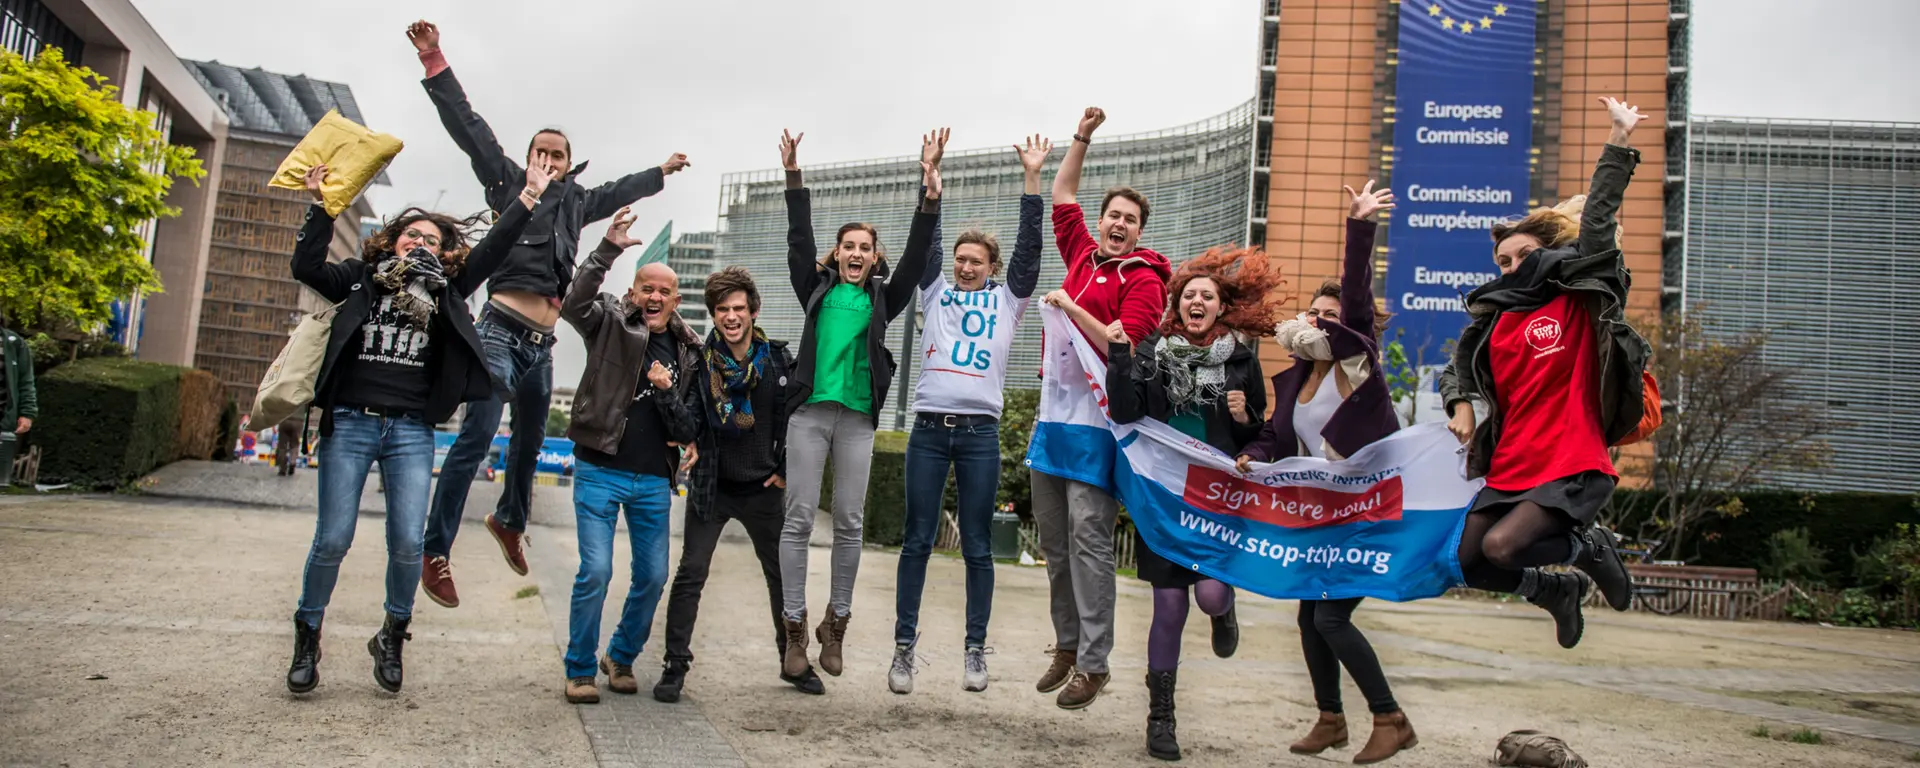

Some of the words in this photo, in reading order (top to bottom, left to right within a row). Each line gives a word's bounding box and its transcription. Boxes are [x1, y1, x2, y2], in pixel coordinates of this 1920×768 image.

[1424, 101, 1503, 121] Europese
[1416, 126, 1509, 145] Commissie
[1407, 184, 1512, 204] Commission
[961, 310, 997, 340] Of
[951, 341, 992, 371] Us
[1206, 482, 1261, 510] Sign
[1271, 493, 1323, 520] here
[1179, 510, 1391, 574] www.stop-ttip.org
